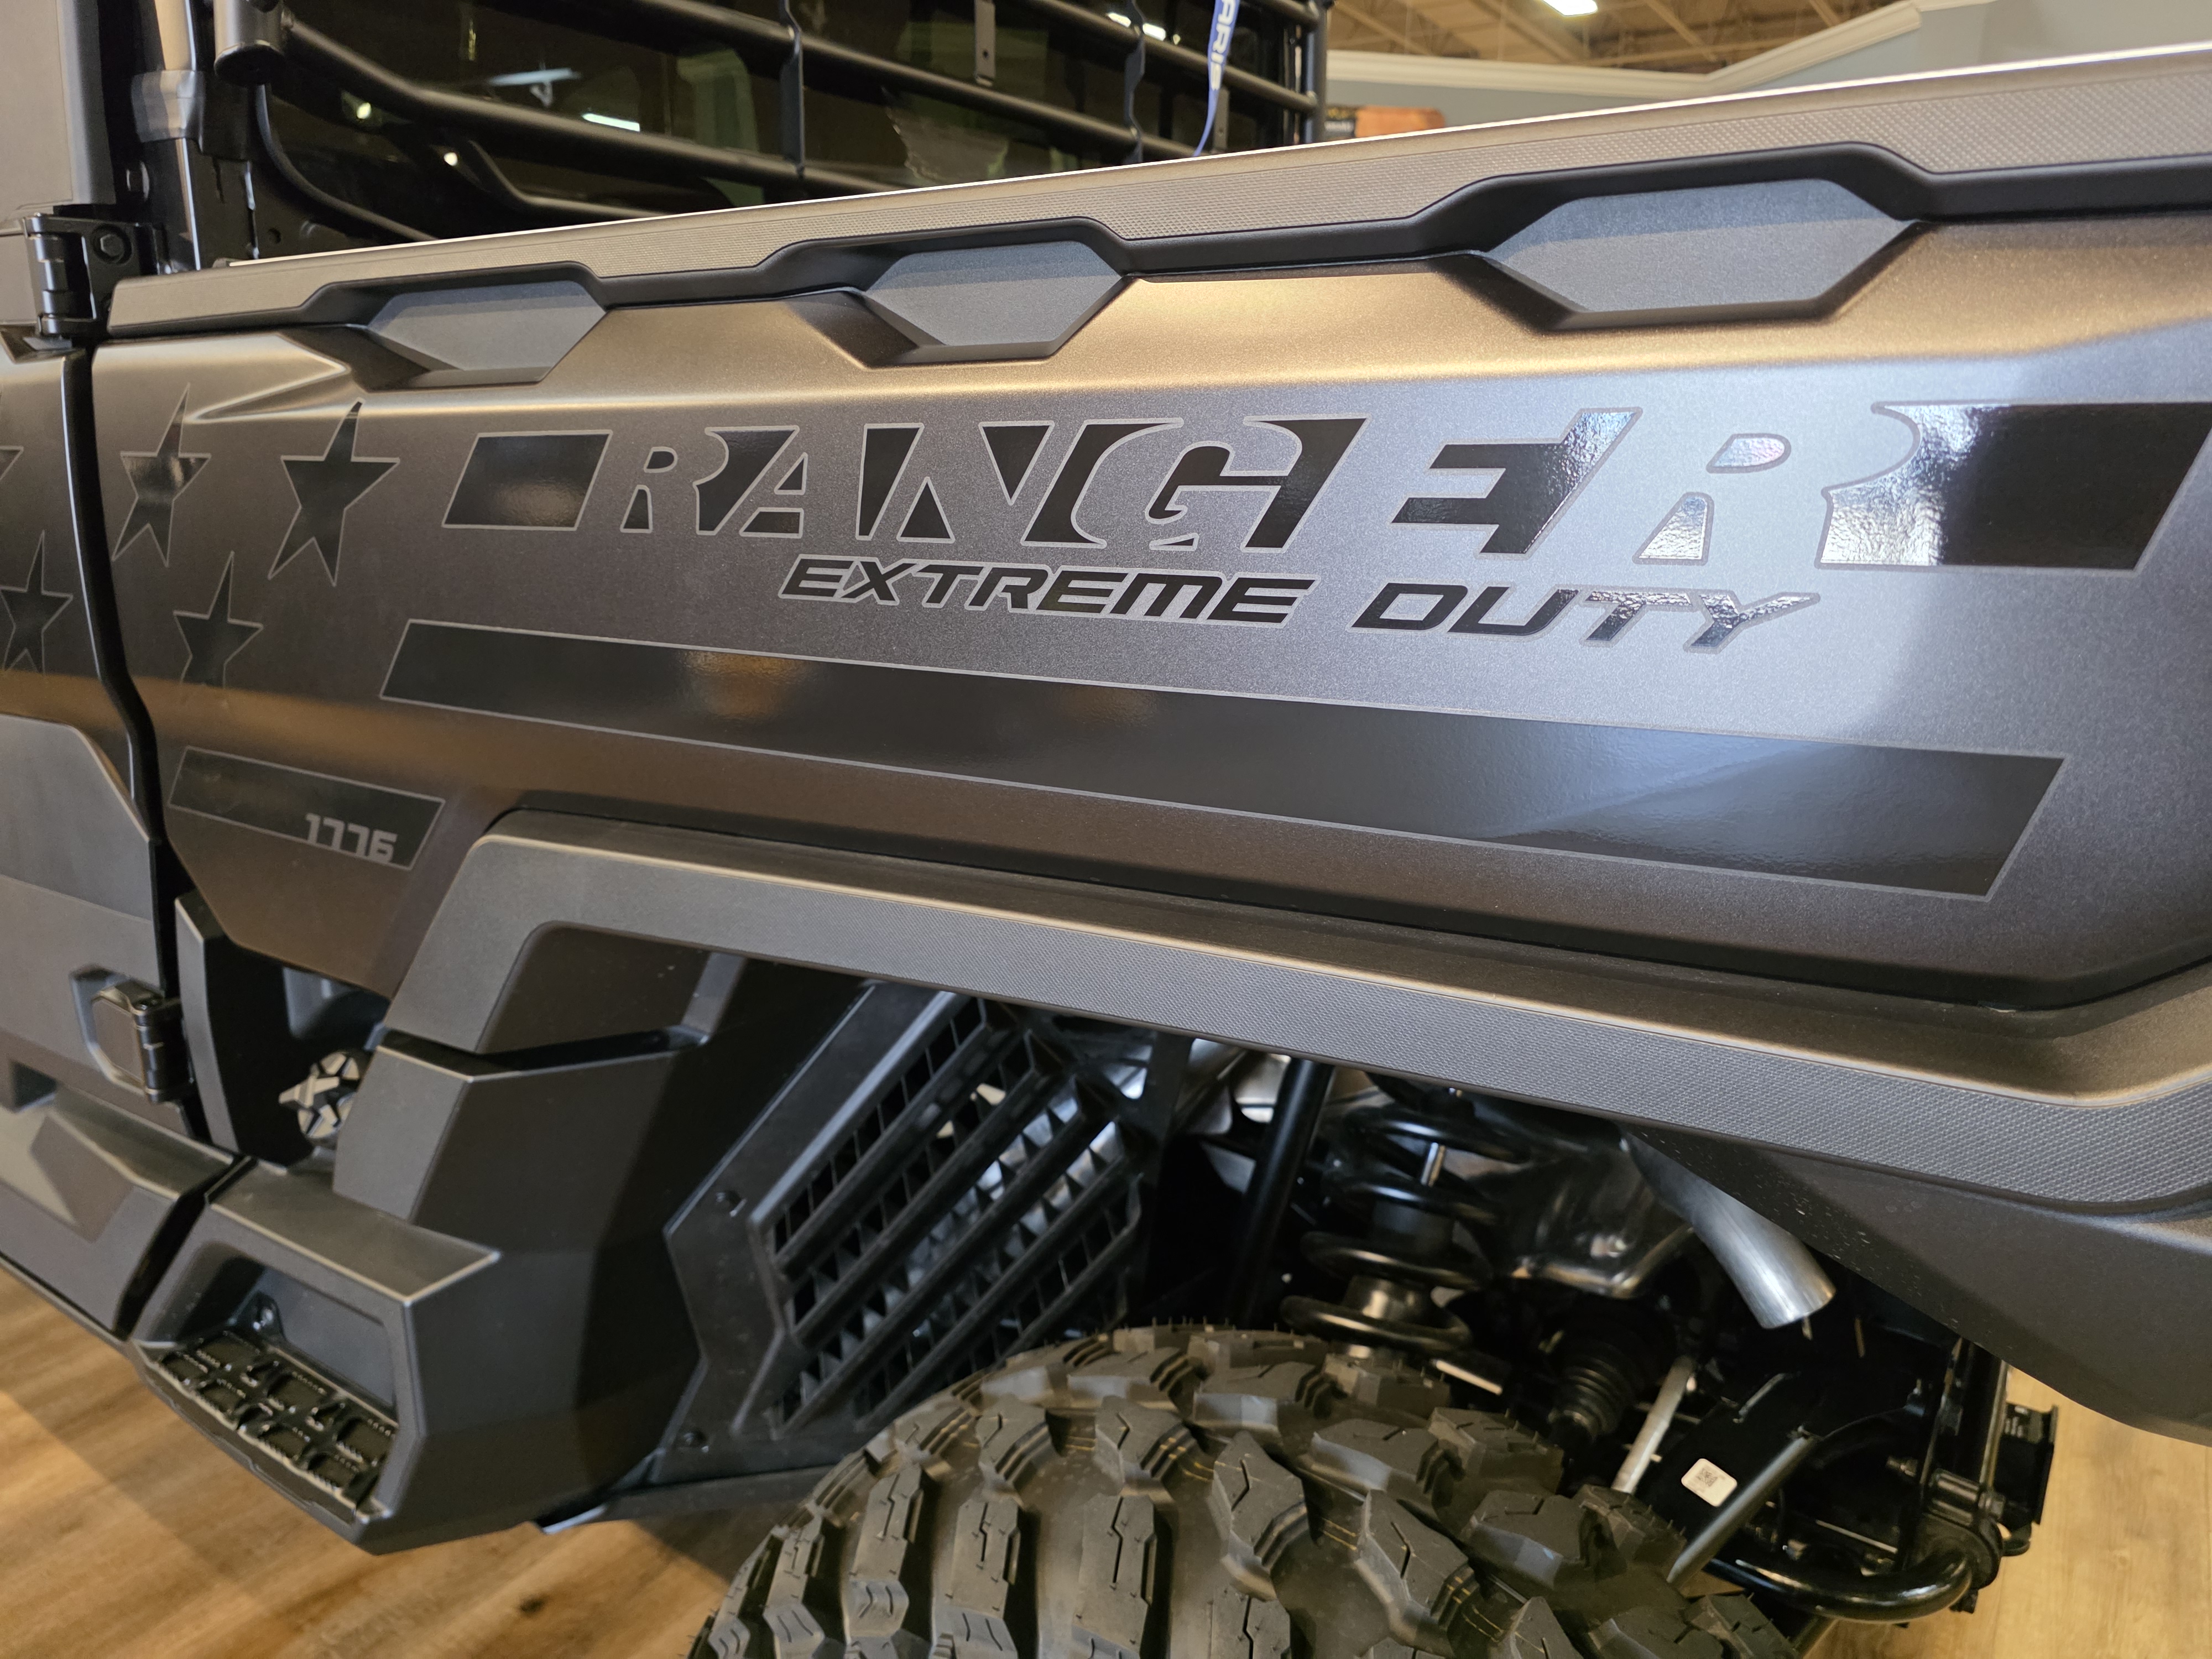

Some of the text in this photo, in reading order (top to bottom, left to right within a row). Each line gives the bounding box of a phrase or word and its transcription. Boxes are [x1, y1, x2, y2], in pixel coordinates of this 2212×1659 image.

[594, 406, 1922, 567] RANGER
[779, 555, 1820, 653] EXTREME DUTY
[305, 813, 398, 863] 1776
